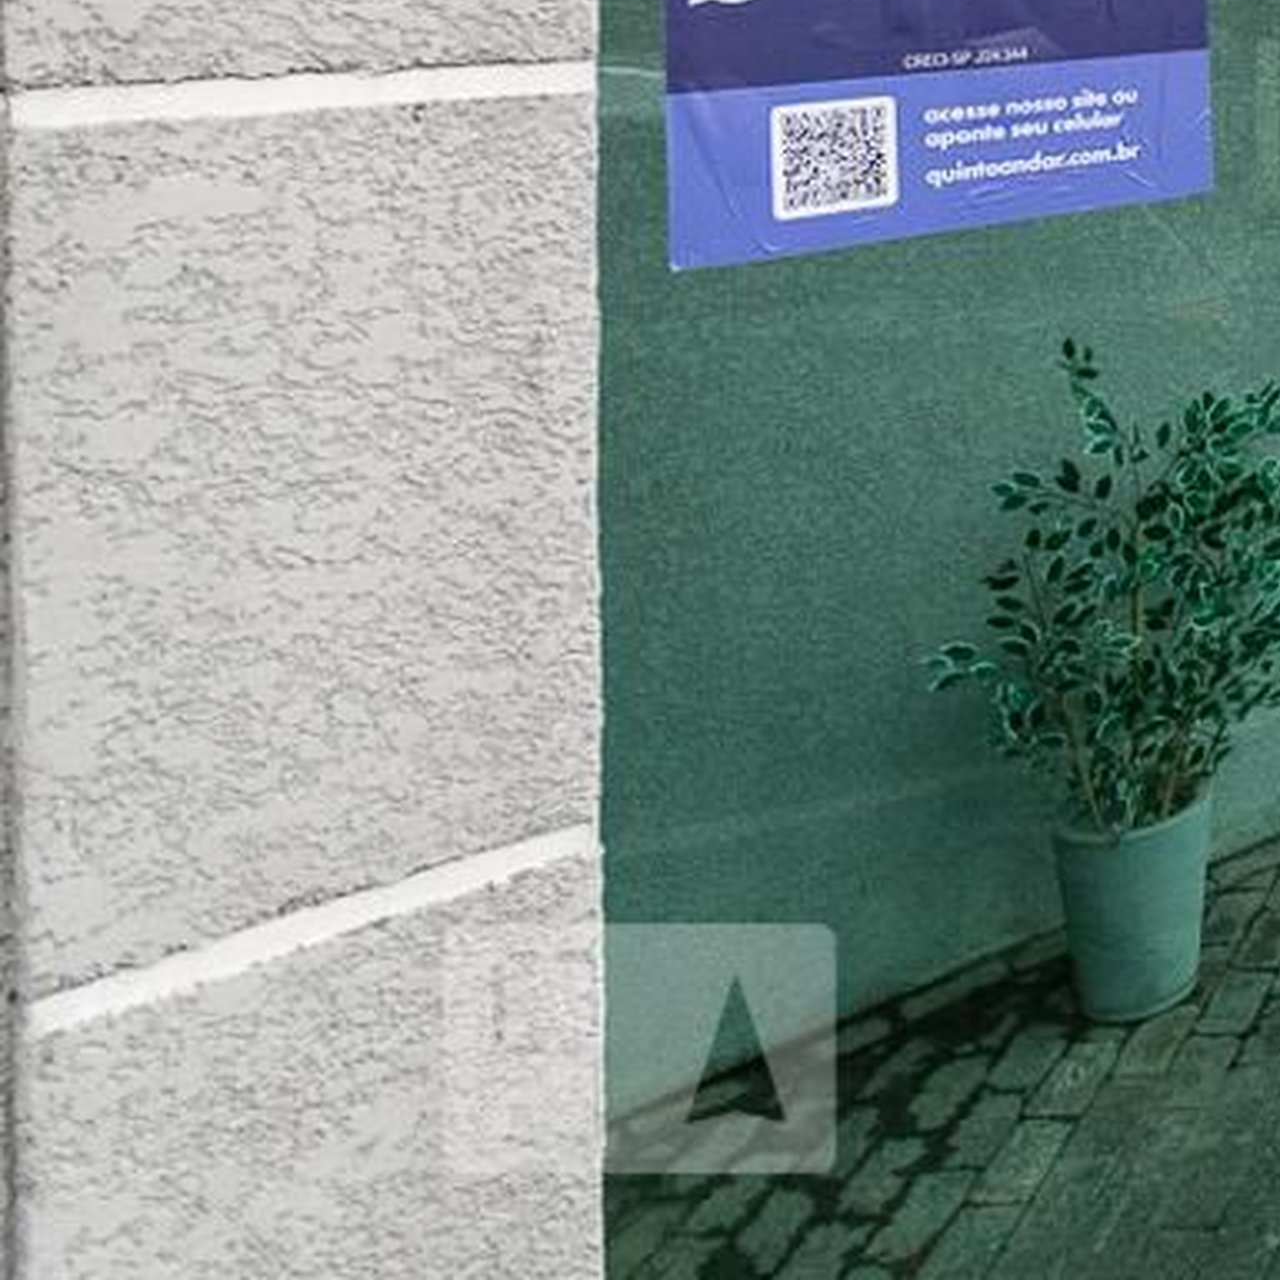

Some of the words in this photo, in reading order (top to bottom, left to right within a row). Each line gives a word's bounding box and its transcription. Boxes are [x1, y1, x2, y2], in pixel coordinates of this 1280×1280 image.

[924, 104, 1001, 124] acesse
[1006, 96, 1068, 115] nosso
[1071, 89, 1107, 108] site
[1112, 90, 1138, 105] ou
[924, 124, 1006, 151] aponte
[1011, 121, 1048, 138] seu
[1052, 110, 1123, 132] celular
[924, 141, 1140, 187] quintoandar.com.br
